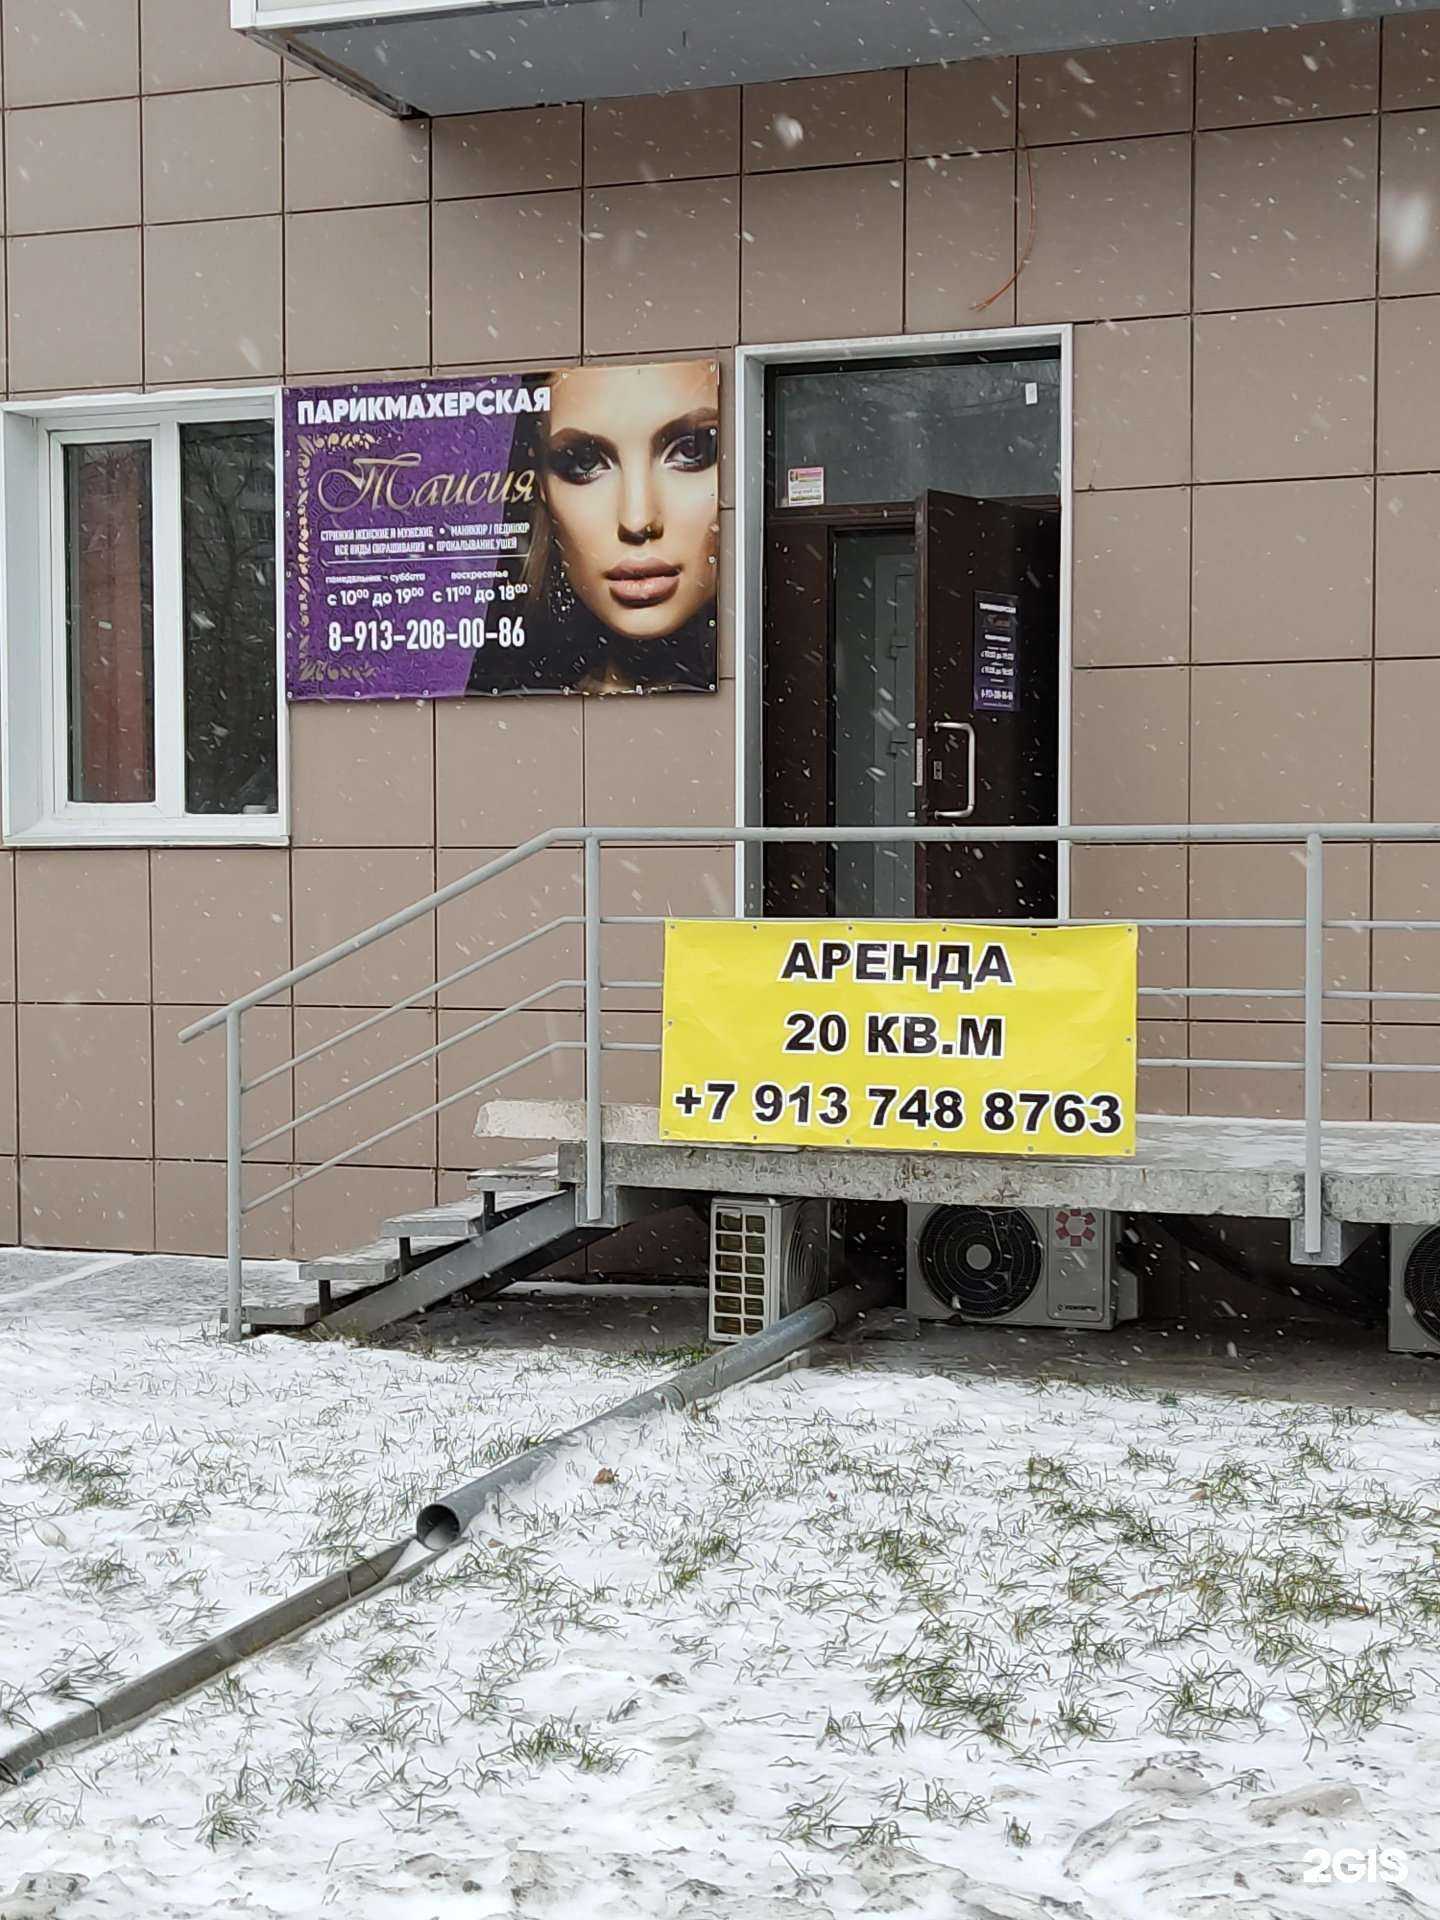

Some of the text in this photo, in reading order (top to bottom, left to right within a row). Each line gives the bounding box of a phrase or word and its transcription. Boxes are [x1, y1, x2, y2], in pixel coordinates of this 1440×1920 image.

[298, 387, 551, 425] ПАРИКМАХЕРСКАЯ
[318, 453, 536, 513] Таисия
[390, 571, 426, 584] суббота
[474, 589, 495, 604] до
[372, 592, 393, 607] до
[328, 616, 525, 651] 8-913-208-00-86
[781, 942, 1013, 990] АРЕНДА
[784, 1013, 1003, 1056] 20 КВ.М
[675, 1083, 1122, 1134] +7 913 748 8763
